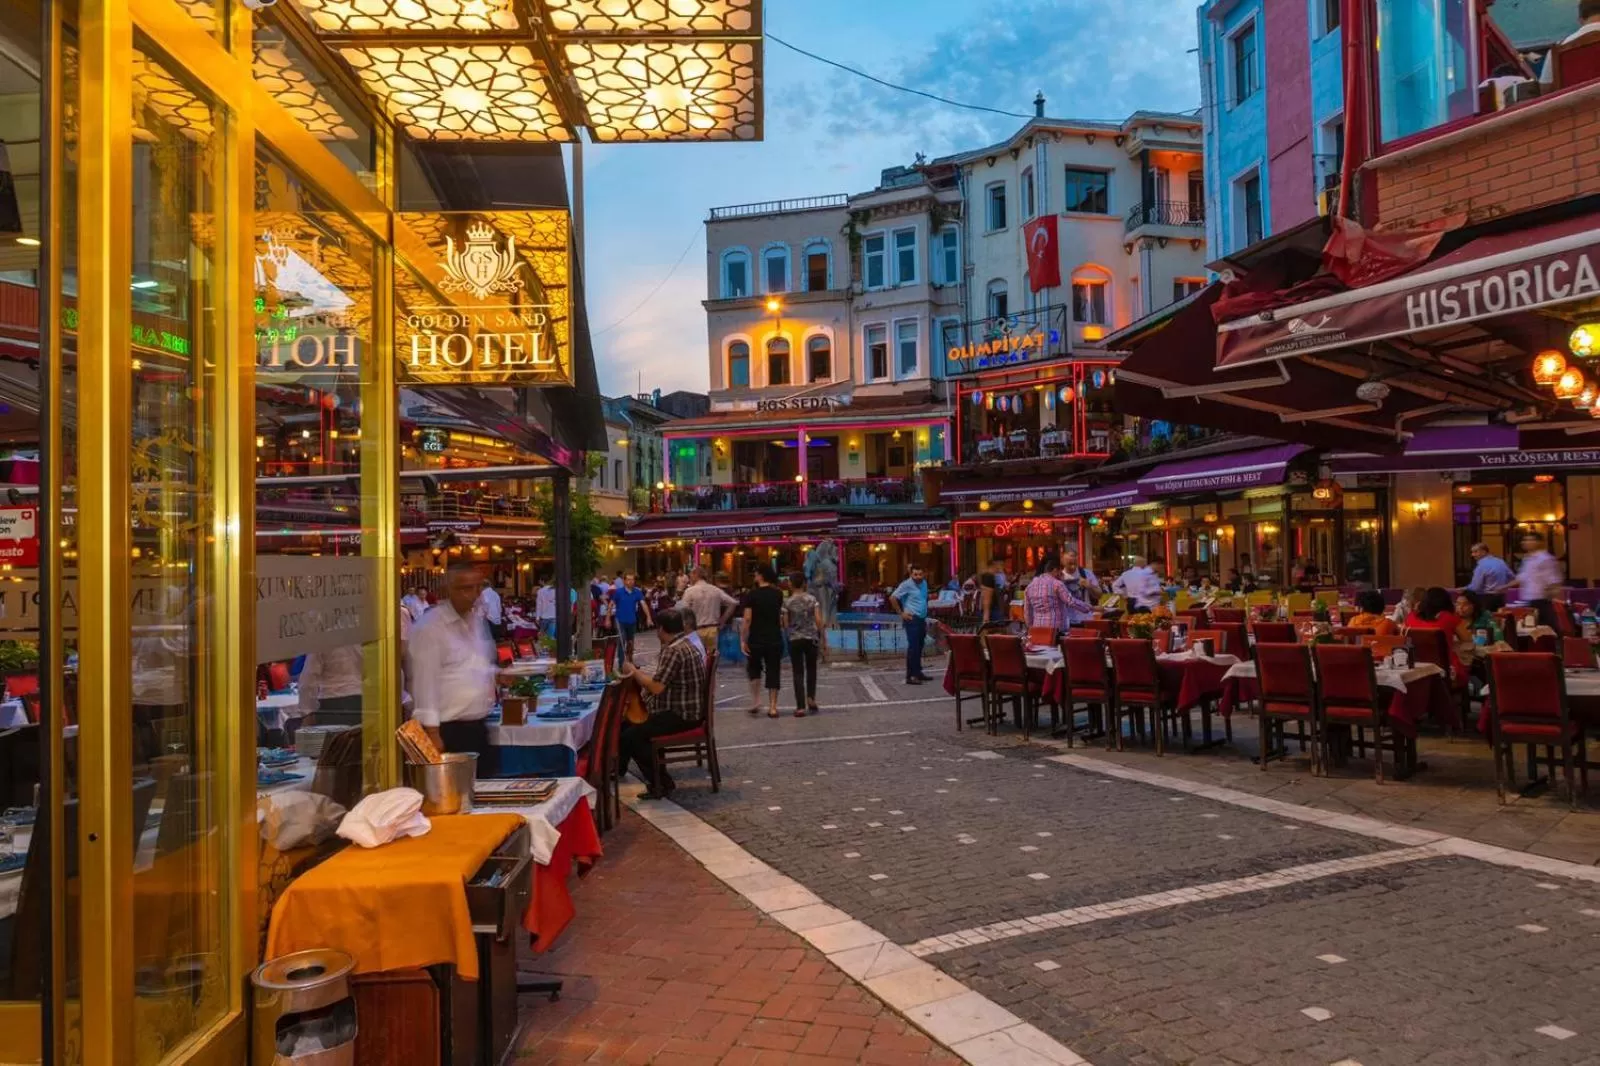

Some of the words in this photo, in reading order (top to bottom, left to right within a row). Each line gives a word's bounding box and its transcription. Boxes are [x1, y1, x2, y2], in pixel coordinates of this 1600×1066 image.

[1406, 254, 1600, 330] HISTORICA
[407, 314, 485, 329] GOLDEN
[495, 312, 547, 327] SAND
[409, 332, 556, 367] HOTEL
[1479, 454, 1506, 464] Yeni
